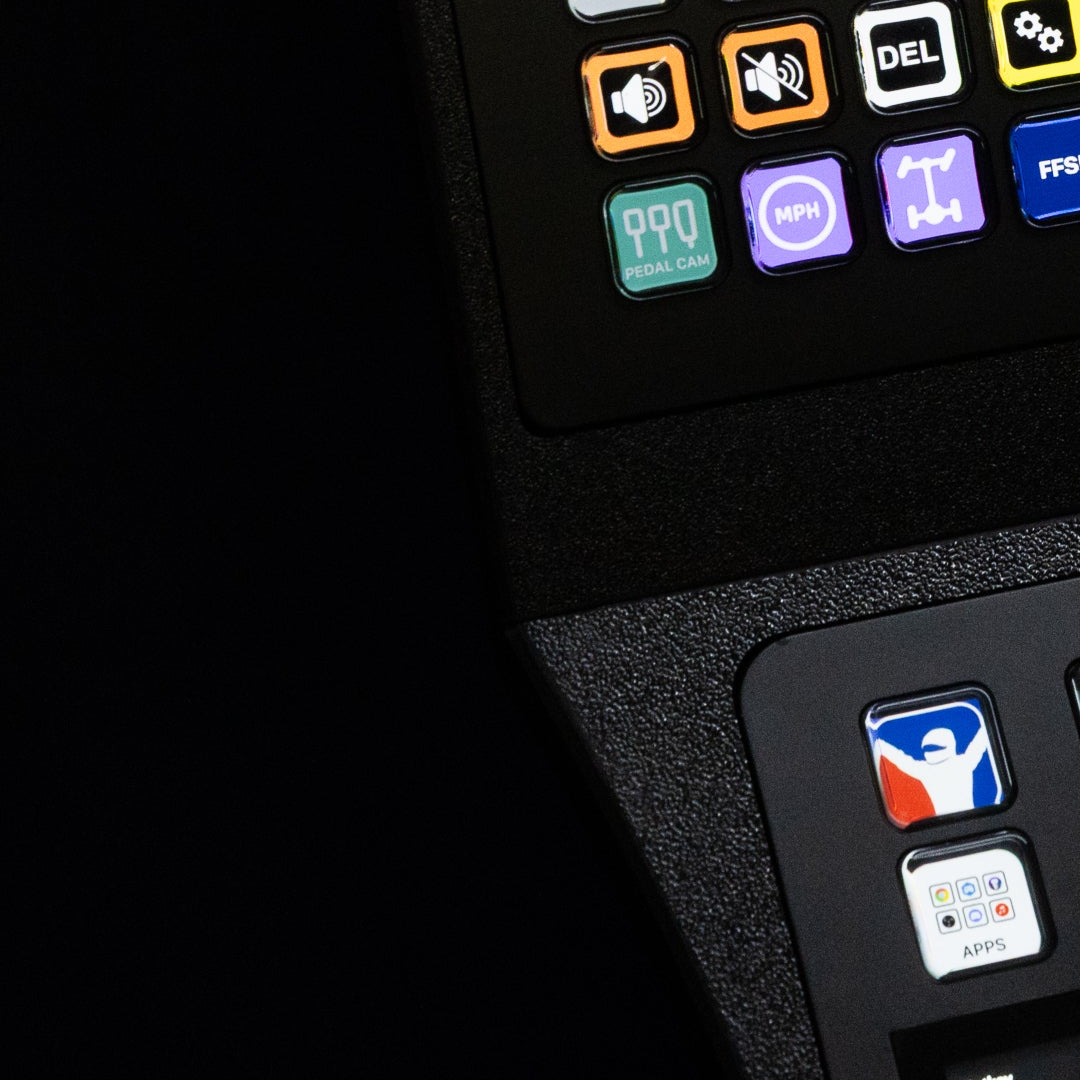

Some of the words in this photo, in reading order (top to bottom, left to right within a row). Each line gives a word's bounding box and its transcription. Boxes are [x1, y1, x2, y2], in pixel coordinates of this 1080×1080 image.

[876, 39, 940, 72] DEL
[774, 201, 821, 226] MPH
[624, 261, 674, 281] PEDAL
[676, 253, 710, 270] CAM
[963, 937, 1007, 960] APPS
